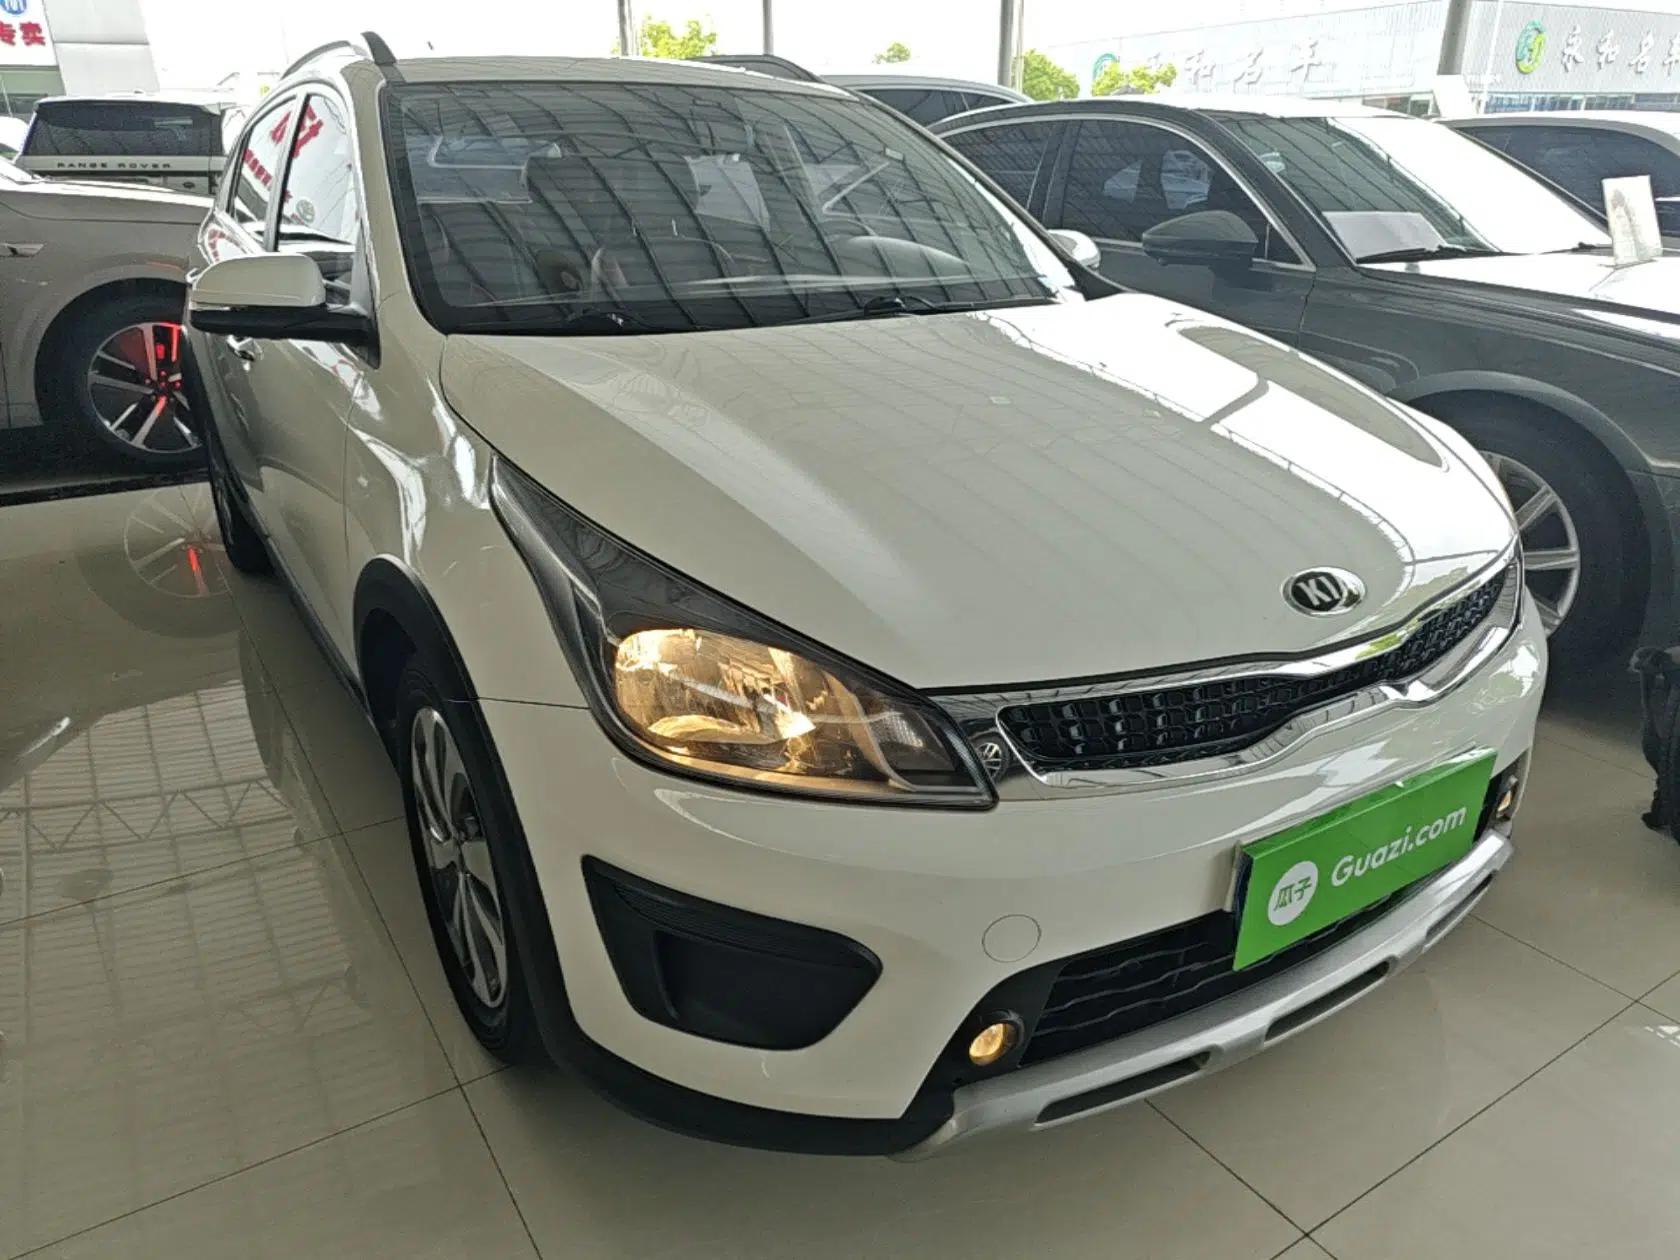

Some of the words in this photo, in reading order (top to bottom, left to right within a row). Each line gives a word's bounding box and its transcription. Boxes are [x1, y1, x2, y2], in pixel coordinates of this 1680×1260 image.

[1295, 575, 1351, 607] KI
[1273, 876, 1312, 912] 瓜子
[1331, 806, 1467, 887] Guazi.com
